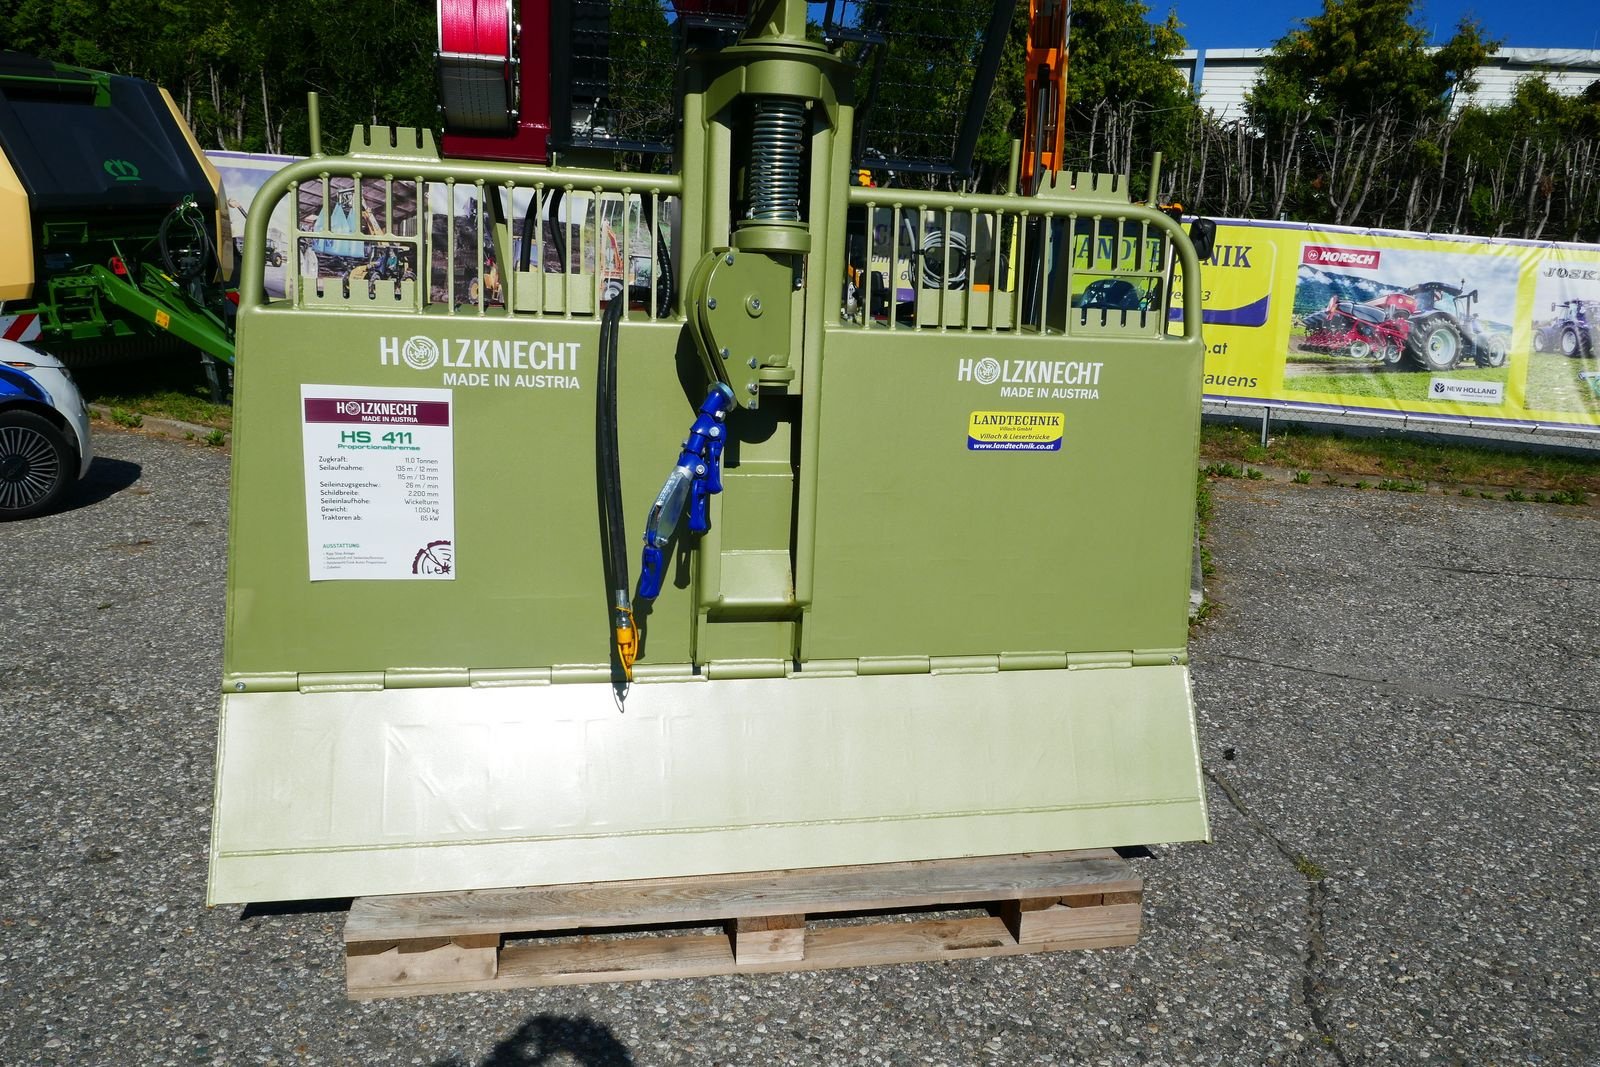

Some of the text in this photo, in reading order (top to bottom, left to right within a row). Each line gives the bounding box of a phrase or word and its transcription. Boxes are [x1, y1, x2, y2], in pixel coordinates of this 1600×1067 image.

[1319, 251, 1375, 265] HORSCH
[1543, 267, 1600, 281] JOSK
[379, 335, 580, 371] HOLZKNECHT
[957, 357, 1104, 385] HOLZKNECHT
[443, 372, 580, 390] MADE IN AUSTRIA
[1000, 386, 1100, 400] MADE IN AUSTRIA
[1446, 385, 1497, 395] NEW HOLLAND
[336, 401, 419, 416] HOLZKNECHT
[973, 414, 1060, 426] LANDTECHNIK
[341, 430, 412, 444] HS 411
[1009, 433, 1051, 441] Lieserbrücke
[337, 443, 421, 451] Proportionalbremse
[973, 442, 1054, 450] www.landtechnik.co.at
[416, 457, 439, 465] Tonnen
[404, 498, 439, 506] Wickelturm
[431, 507, 439, 515] kg
